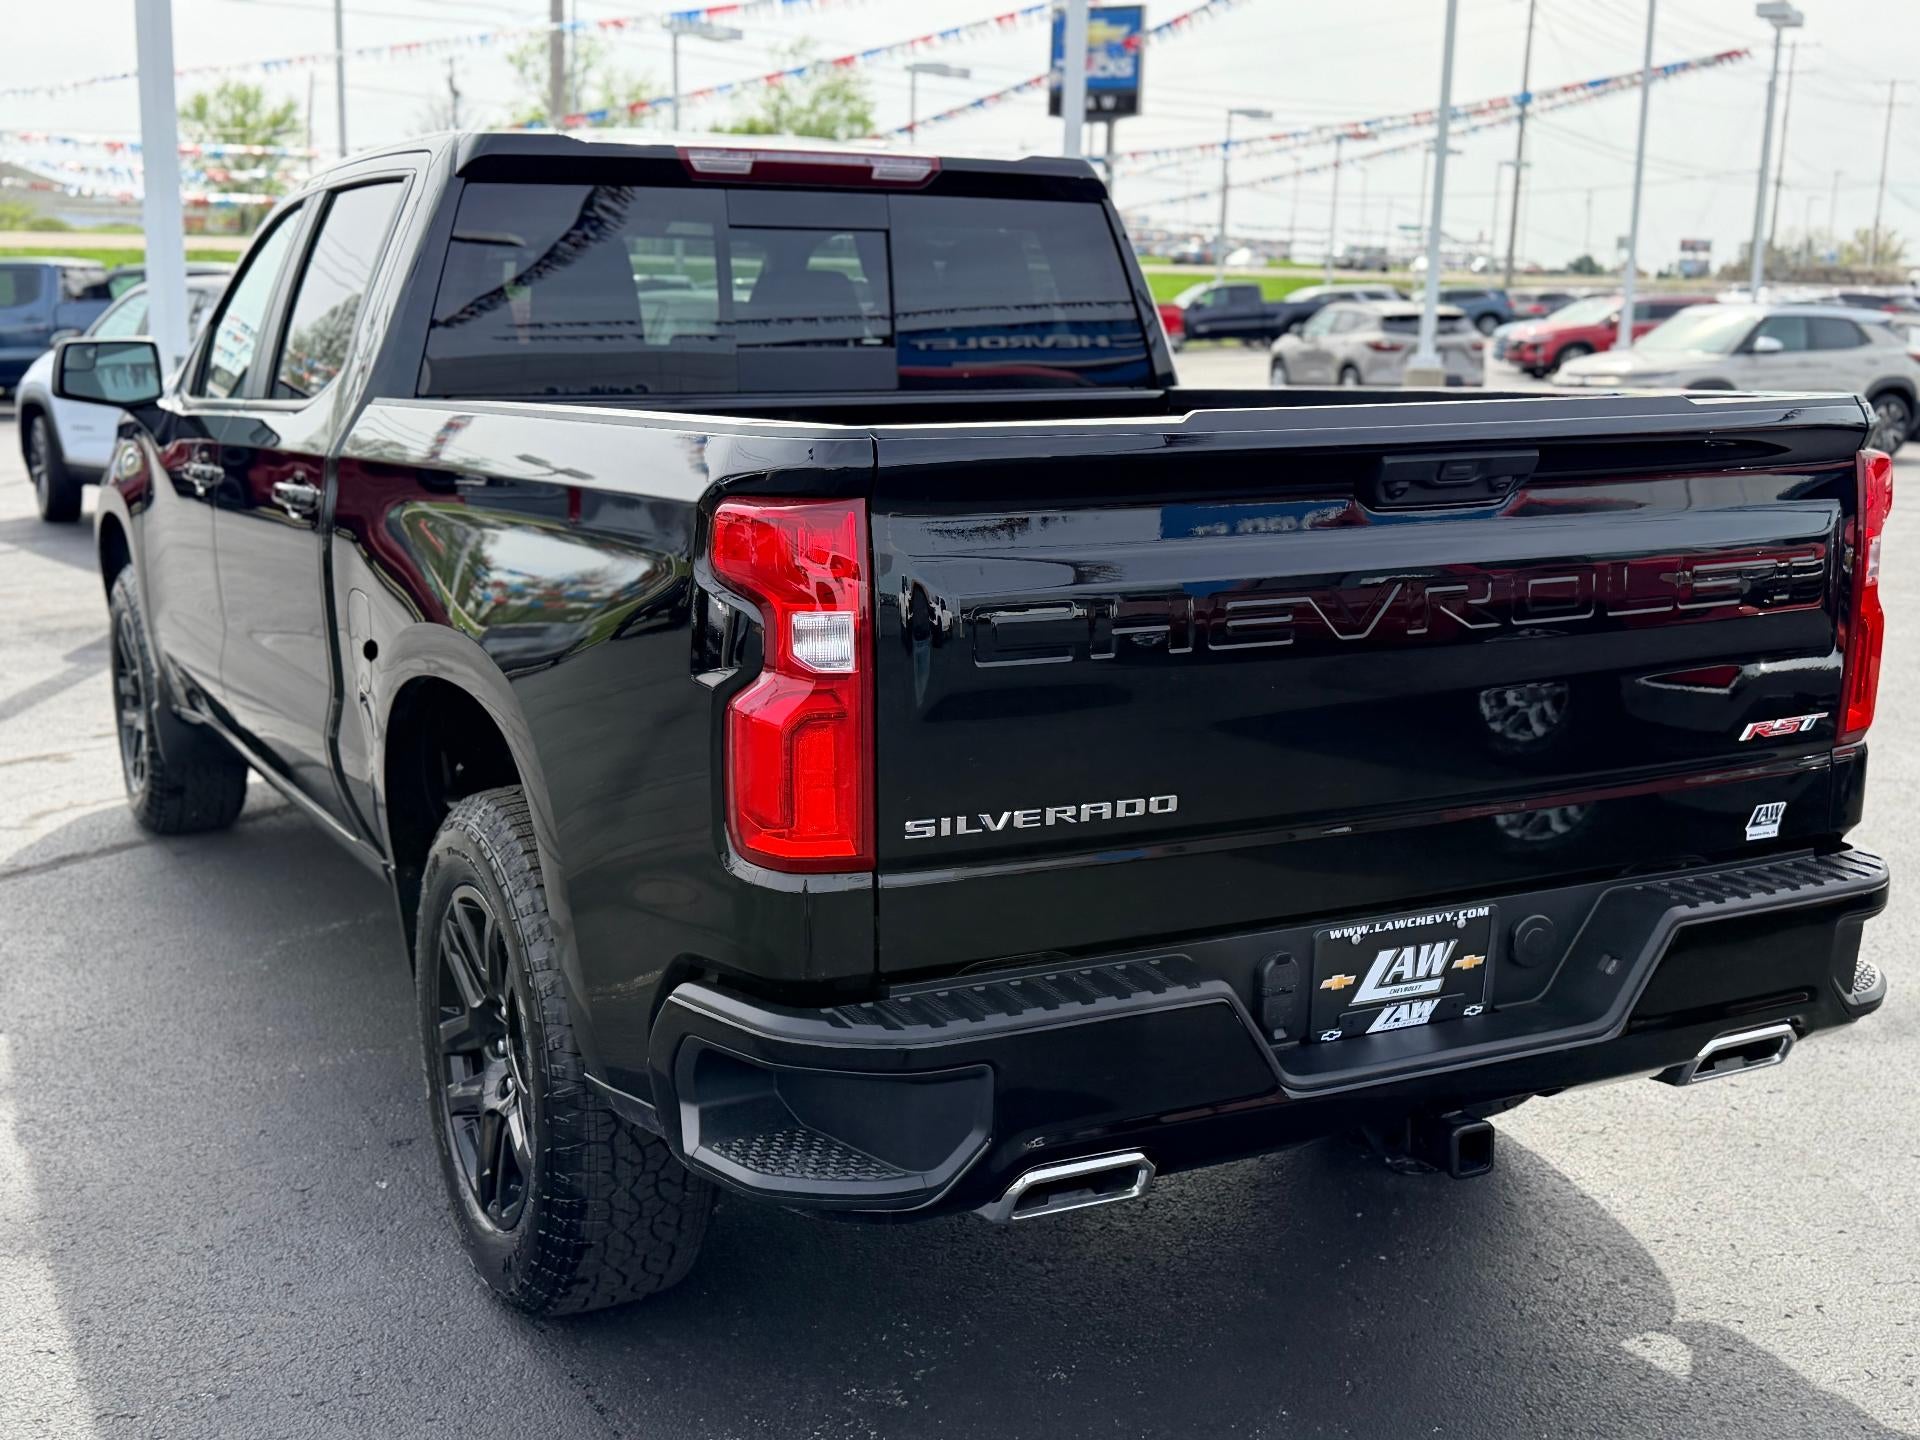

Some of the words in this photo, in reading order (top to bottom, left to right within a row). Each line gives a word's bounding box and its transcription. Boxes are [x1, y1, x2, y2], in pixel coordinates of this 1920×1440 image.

[972, 555, 1825, 668] CHEVROLET
[1738, 712, 1829, 741] RST
[904, 795, 1178, 839] SILVERADO
[1329, 906, 1490, 940] WWW.LAWCHEVY.COM
[1349, 939, 1458, 1005] LAW
[1365, 999, 1441, 1034] LAW
